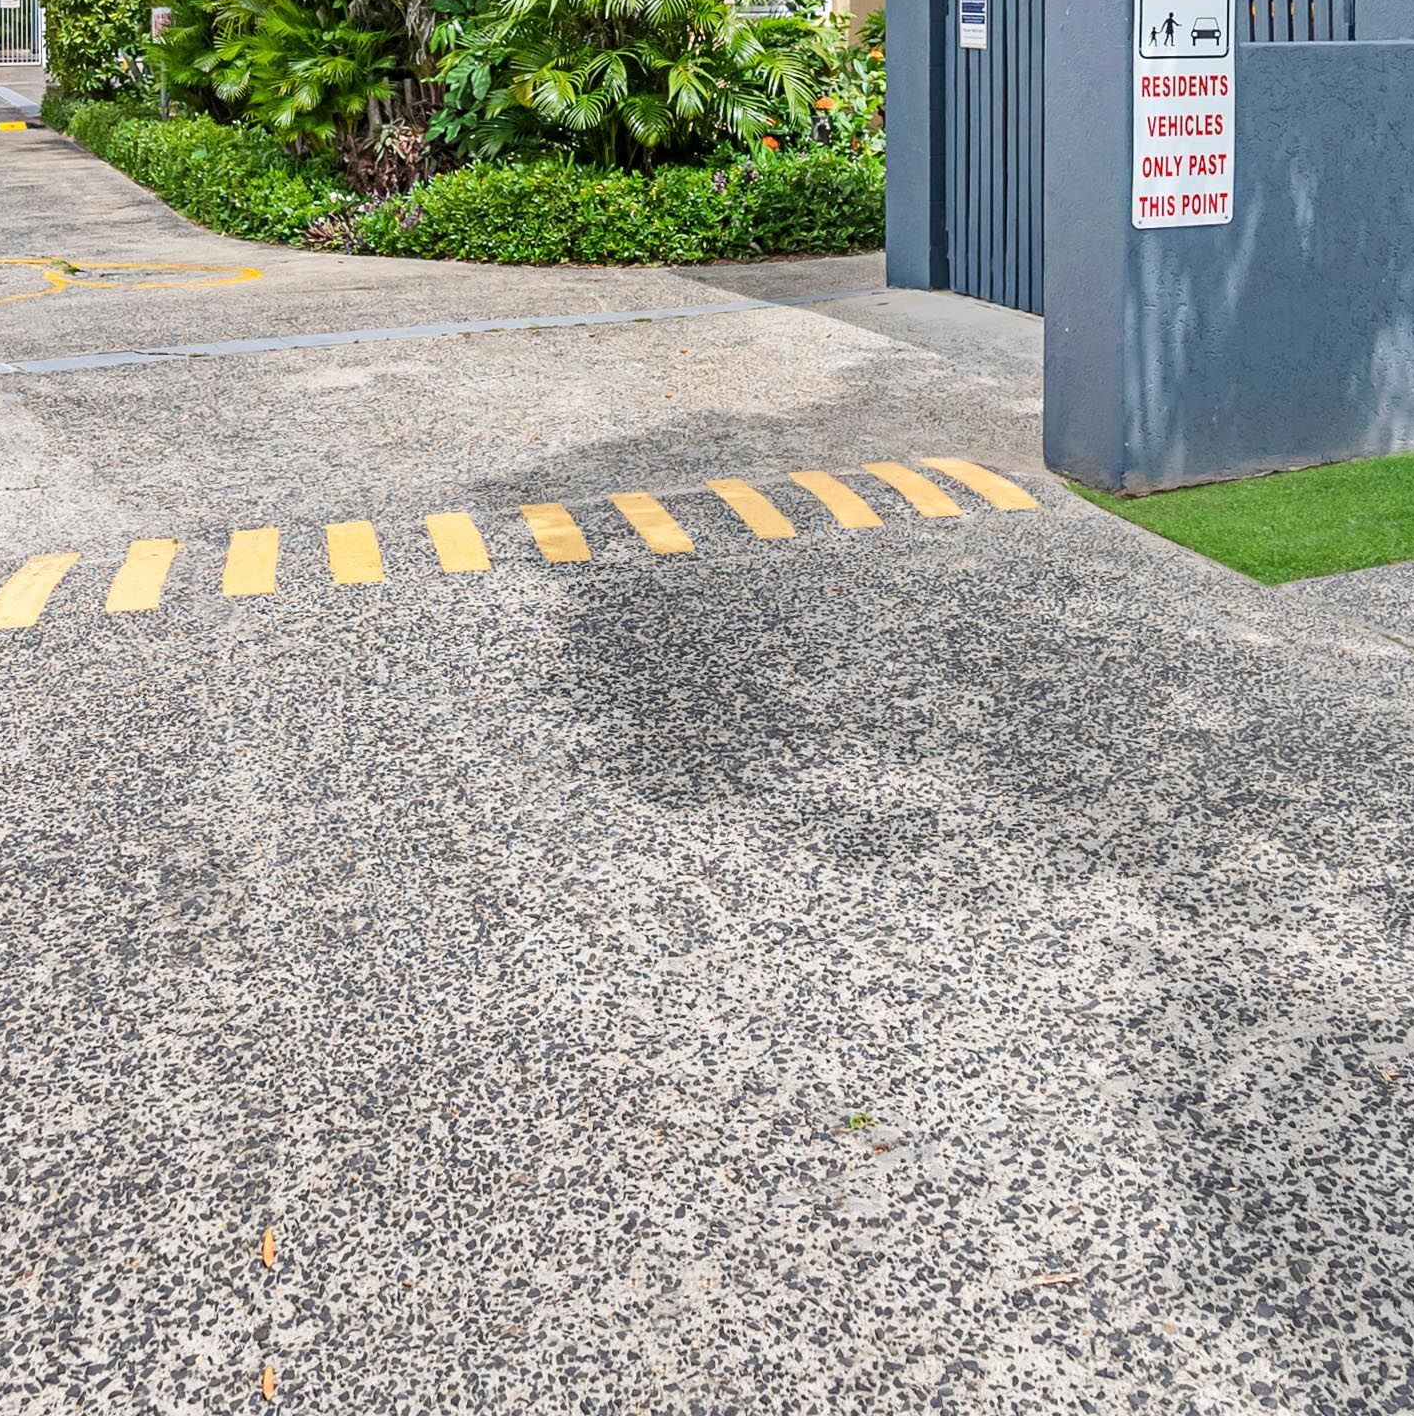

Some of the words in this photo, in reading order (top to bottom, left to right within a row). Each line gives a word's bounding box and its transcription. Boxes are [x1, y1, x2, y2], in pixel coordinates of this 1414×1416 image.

[1141, 75, 1228, 98] RESIDENTS
[1147, 114, 1224, 137] VEHICLES
[1142, 155, 1183, 178] ONLY
[1188, 154, 1227, 176] PAST
[1139, 195, 1176, 218] THIS
[1182, 193, 1228, 216] POINT
